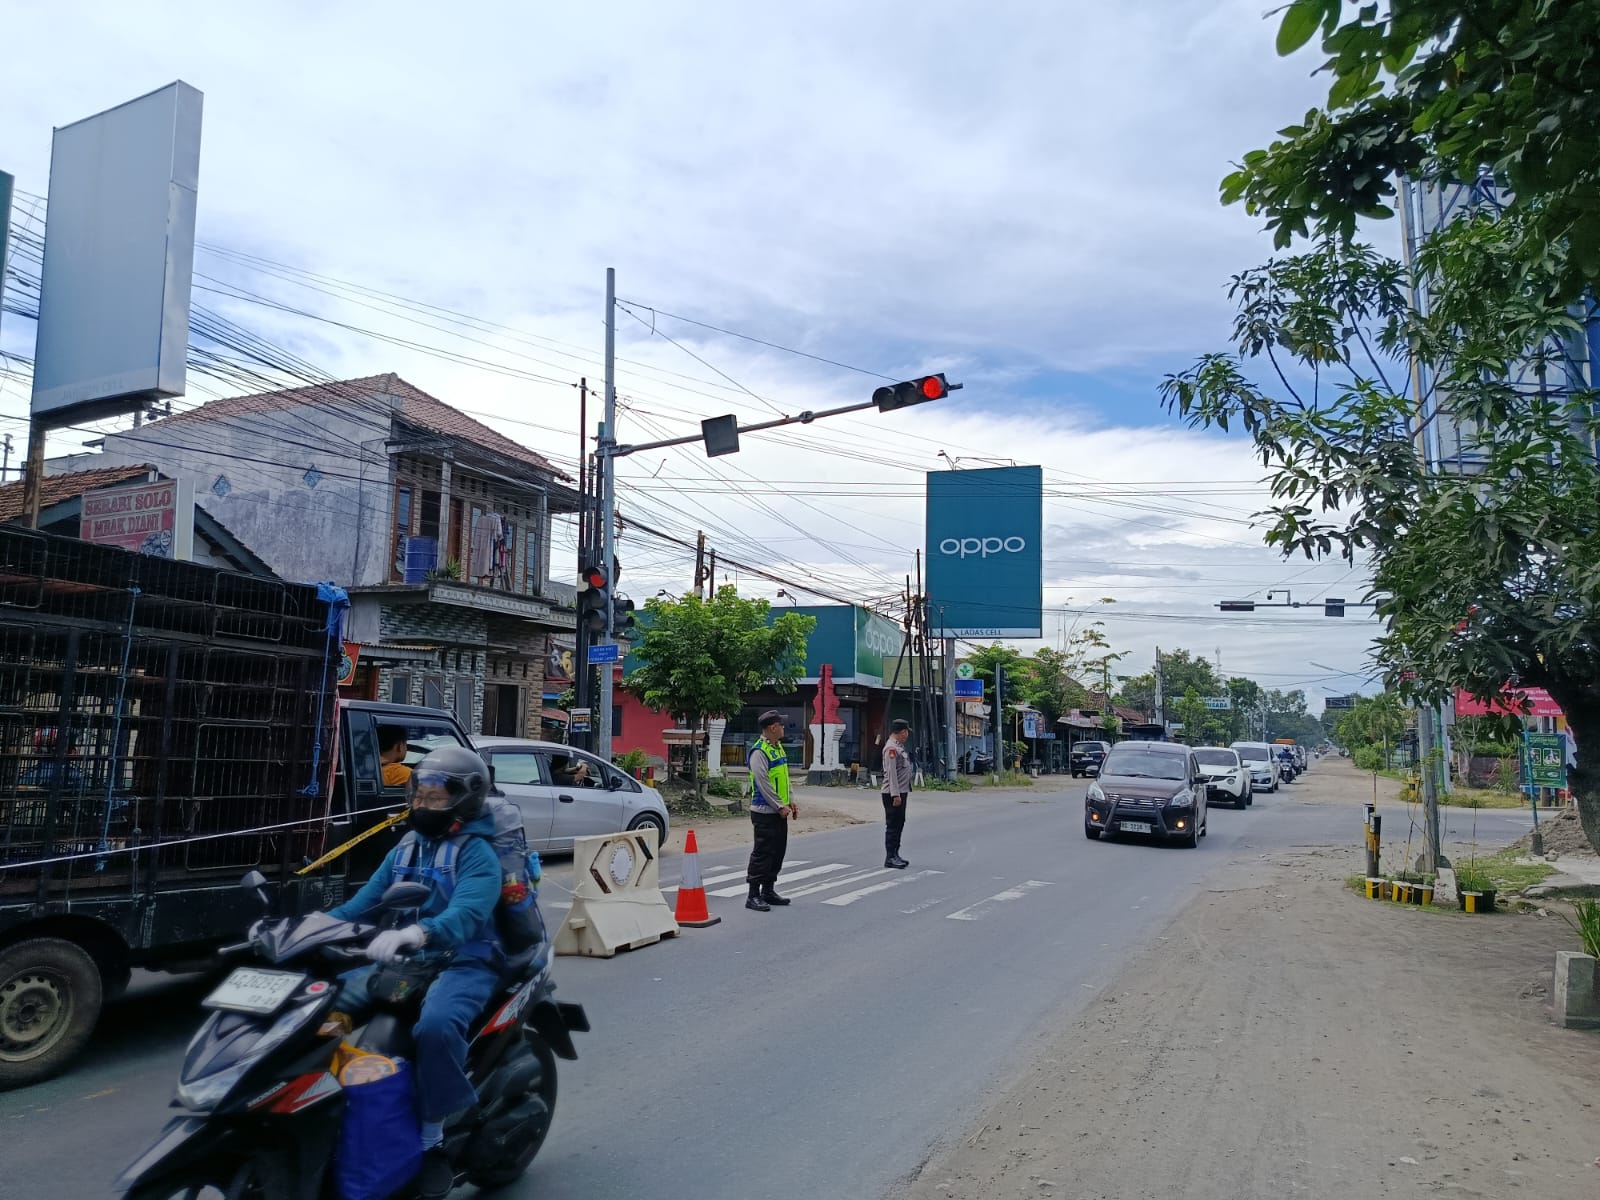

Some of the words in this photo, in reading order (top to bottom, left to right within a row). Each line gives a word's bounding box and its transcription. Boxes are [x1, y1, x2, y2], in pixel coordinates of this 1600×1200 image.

[85, 495, 132, 516] SERABI
[135, 490, 171, 510] SOLO
[940, 537, 1025, 559] oppo
